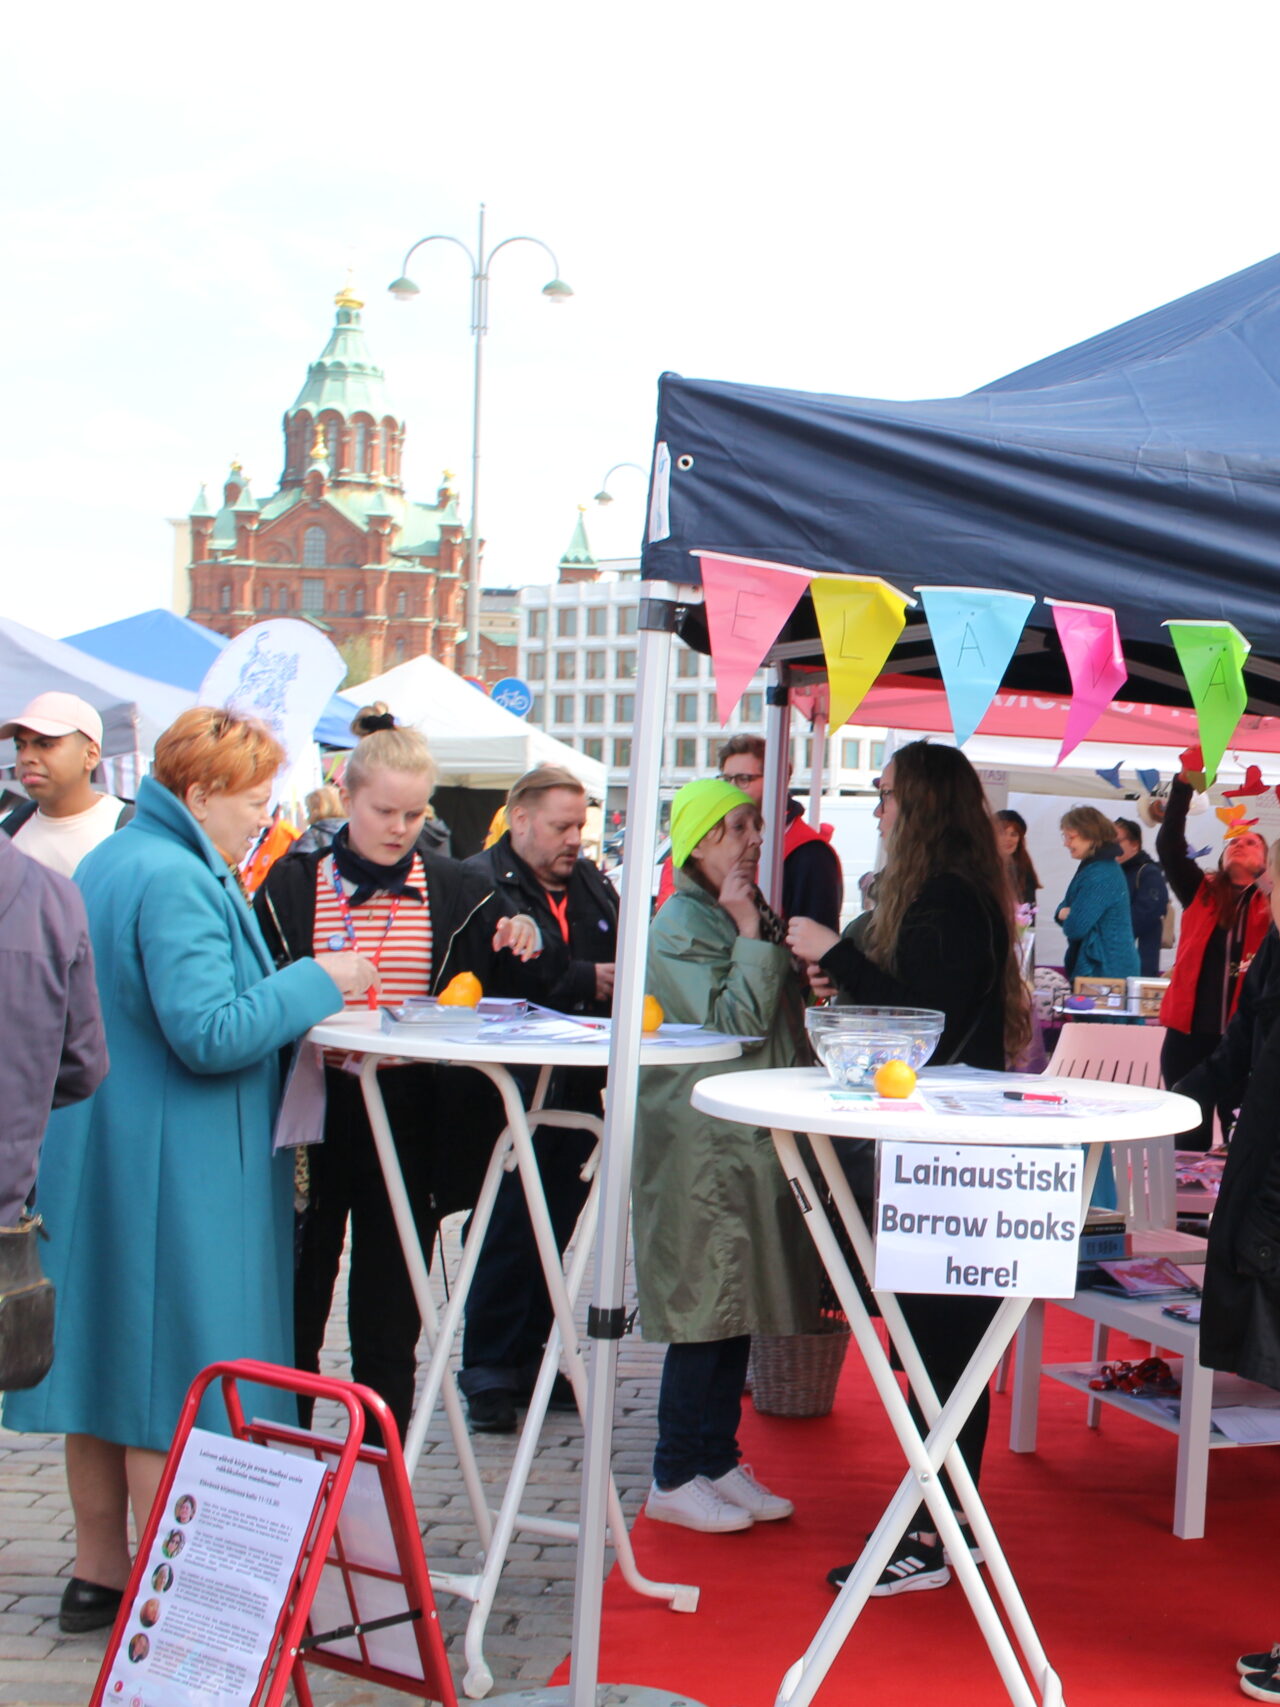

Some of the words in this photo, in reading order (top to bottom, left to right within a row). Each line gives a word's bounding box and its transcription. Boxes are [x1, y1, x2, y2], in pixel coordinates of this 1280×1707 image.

[894, 1154, 1077, 1192] Lainaustiski
[881, 1204, 988, 1237] Borrow
[996, 1211, 1076, 1241] books
[946, 1256, 1018, 1287] here!
